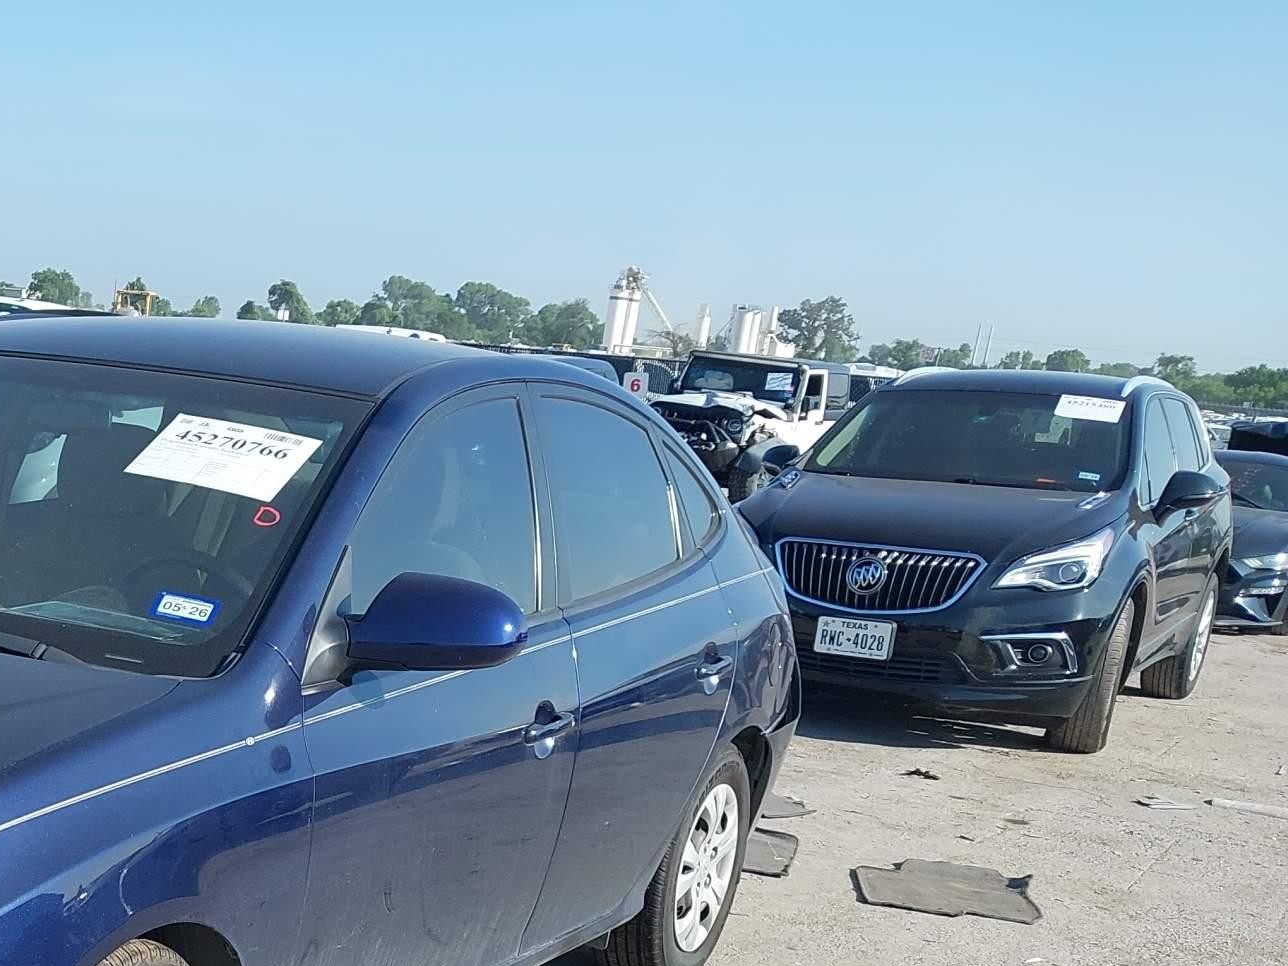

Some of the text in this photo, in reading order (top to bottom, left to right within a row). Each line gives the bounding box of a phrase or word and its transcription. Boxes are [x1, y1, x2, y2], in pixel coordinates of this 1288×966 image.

[631, 378, 641, 392] 6
[175, 430, 294, 460] 45270766
[841, 621, 869, 631] TEXAS
